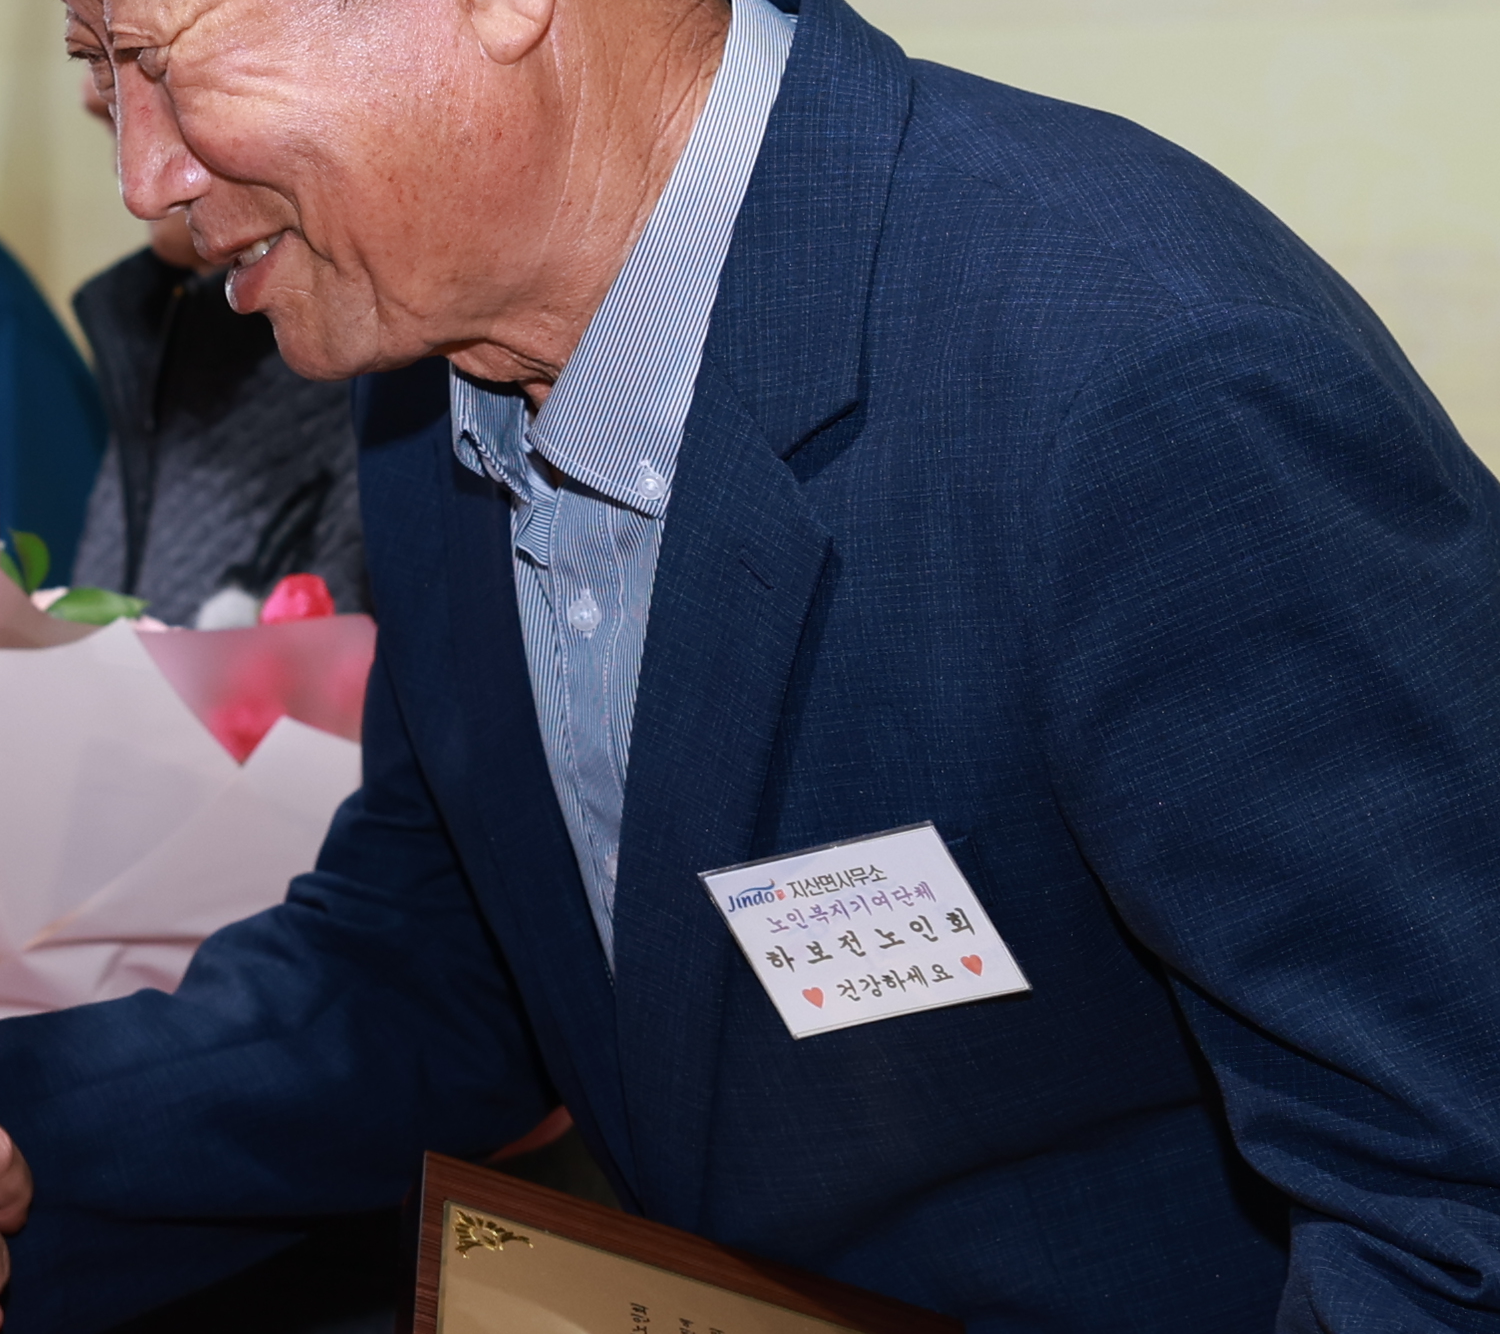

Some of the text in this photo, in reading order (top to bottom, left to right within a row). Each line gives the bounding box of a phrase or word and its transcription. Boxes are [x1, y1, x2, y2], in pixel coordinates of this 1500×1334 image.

[728, 865, 888, 913] Jindo 지산면사무소
[767, 881, 937, 934] 노인복지기여단체
[836, 963, 954, 1002] 건강하세요
